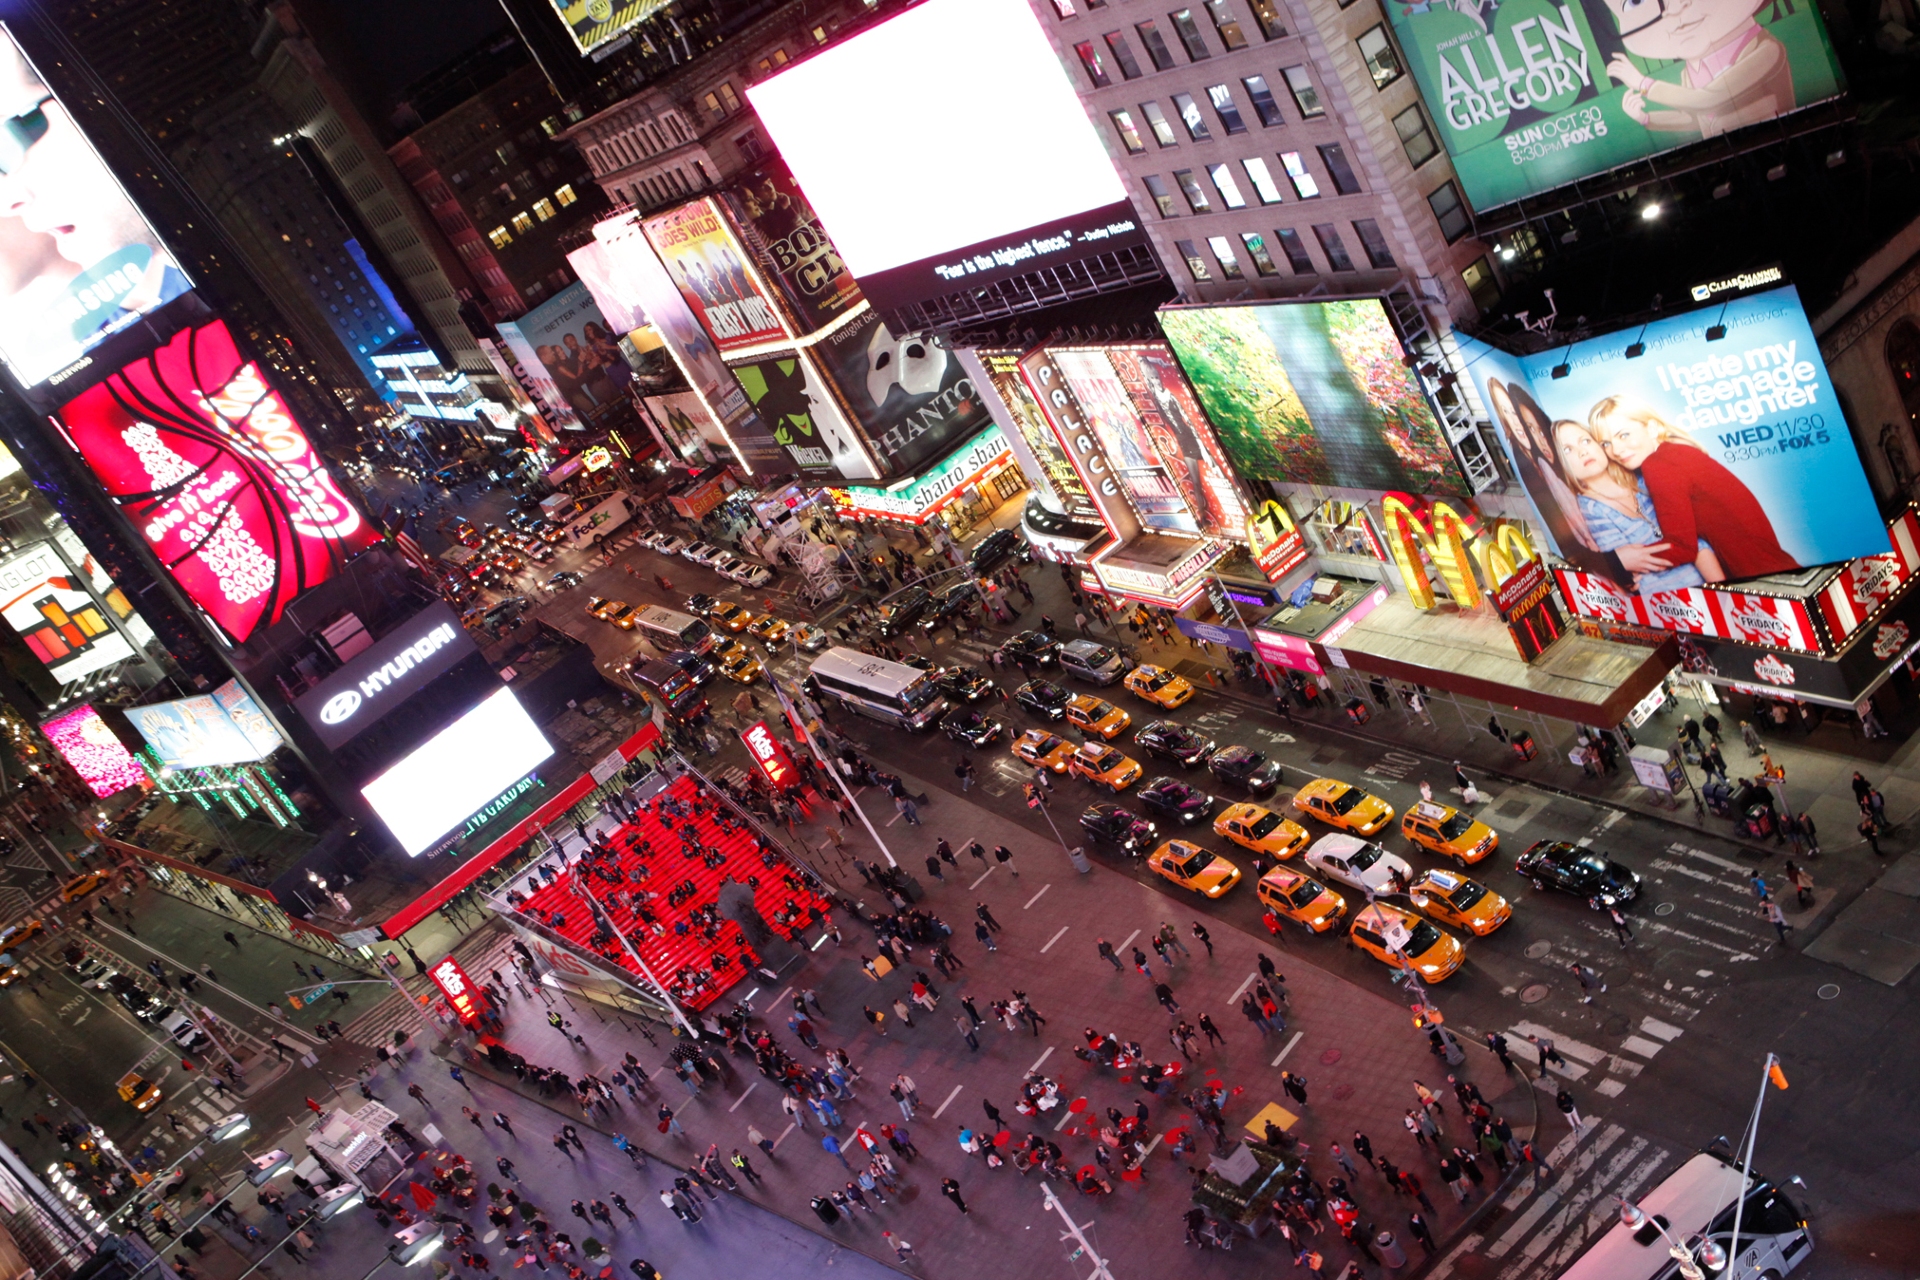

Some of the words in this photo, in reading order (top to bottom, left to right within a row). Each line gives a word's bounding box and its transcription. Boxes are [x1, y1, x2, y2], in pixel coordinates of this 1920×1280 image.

[1436, 37, 1458, 53] JONAH
[1458, 31, 1475, 47] HILL
[1439, 5, 1586, 103] ALLEN
[1445, 51, 1591, 131] GREGORY
[1504, 125, 1544, 151] SUN
[1542, 112, 1578, 138] OCT
[1579, 106, 1602, 127] 30
[1510, 141, 1562, 166] 8:30PM
[1562, 127, 1595, 148] FOX
[1593, 121, 1608, 137] 5
[657, 228, 688, 250] GOES
[687, 214, 722, 242] WILD!
[795, 250, 847, 296] CL
[963, 258, 977, 273] is
[974, 253, 995, 270] the
[992, 241, 1036, 266] highest
[544, 308, 577, 334] BETTER
[579, 296, 595, 310] WO
[558, 290, 580, 306] WITH
[704, 300, 751, 340] JERSEY
[741, 296, 780, 334] BOYS
[829, 314, 864, 346] Tonight
[1726, 306, 1788, 331] whatever.
[48, 355, 93, 386] SHERWOOD
[1655, 365, 1671, 392] I
[1671, 349, 1738, 389] hate
[1744, 339, 1797, 374] my
[501, 346, 563, 433] MUPPETS
[1070, 377, 1121, 404] HEART
[1680, 360, 1817, 408] teenage
[866, 377, 977, 456] PHANTO
[1675, 382, 1819, 433] daughter
[1038, 365, 1118, 497] PALACE
[1110, 351, 1222, 536] CHICAGO
[1718, 424, 1775, 449] WED
[1772, 413, 1826, 438] 11/30
[1723, 445, 1779, 465] 9:30PM
[1778, 434, 1816, 453] FOX
[1815, 429, 1832, 446] 5
[693, 488, 723, 513] GIFTS
[912, 465, 966, 512] sbarro
[1124, 474, 1178, 499] PRISCILLA
[145, 510, 185, 542] give
[197, 470, 241, 504] back
[572, 510, 611, 539] FedEx
[1259, 532, 1300, 568] McDonald's
[0, 553, 52, 592] GLOT
[1169, 550, 1210, 587] PRISCILLA
[1270, 567, 1286, 581] OPEN
[1499, 563, 1543, 606] McDonald's
[1583, 625, 1600, 638] 47
[358, 622, 457, 698] HYUNDAI
[749, 726, 775, 759] tkts
[427, 829, 466, 860] SHERWOOD
[436, 962, 465, 995] tkts
[57, 994, 86, 1020] ONLY
[341, 1130, 368, 1158] snackBOX
